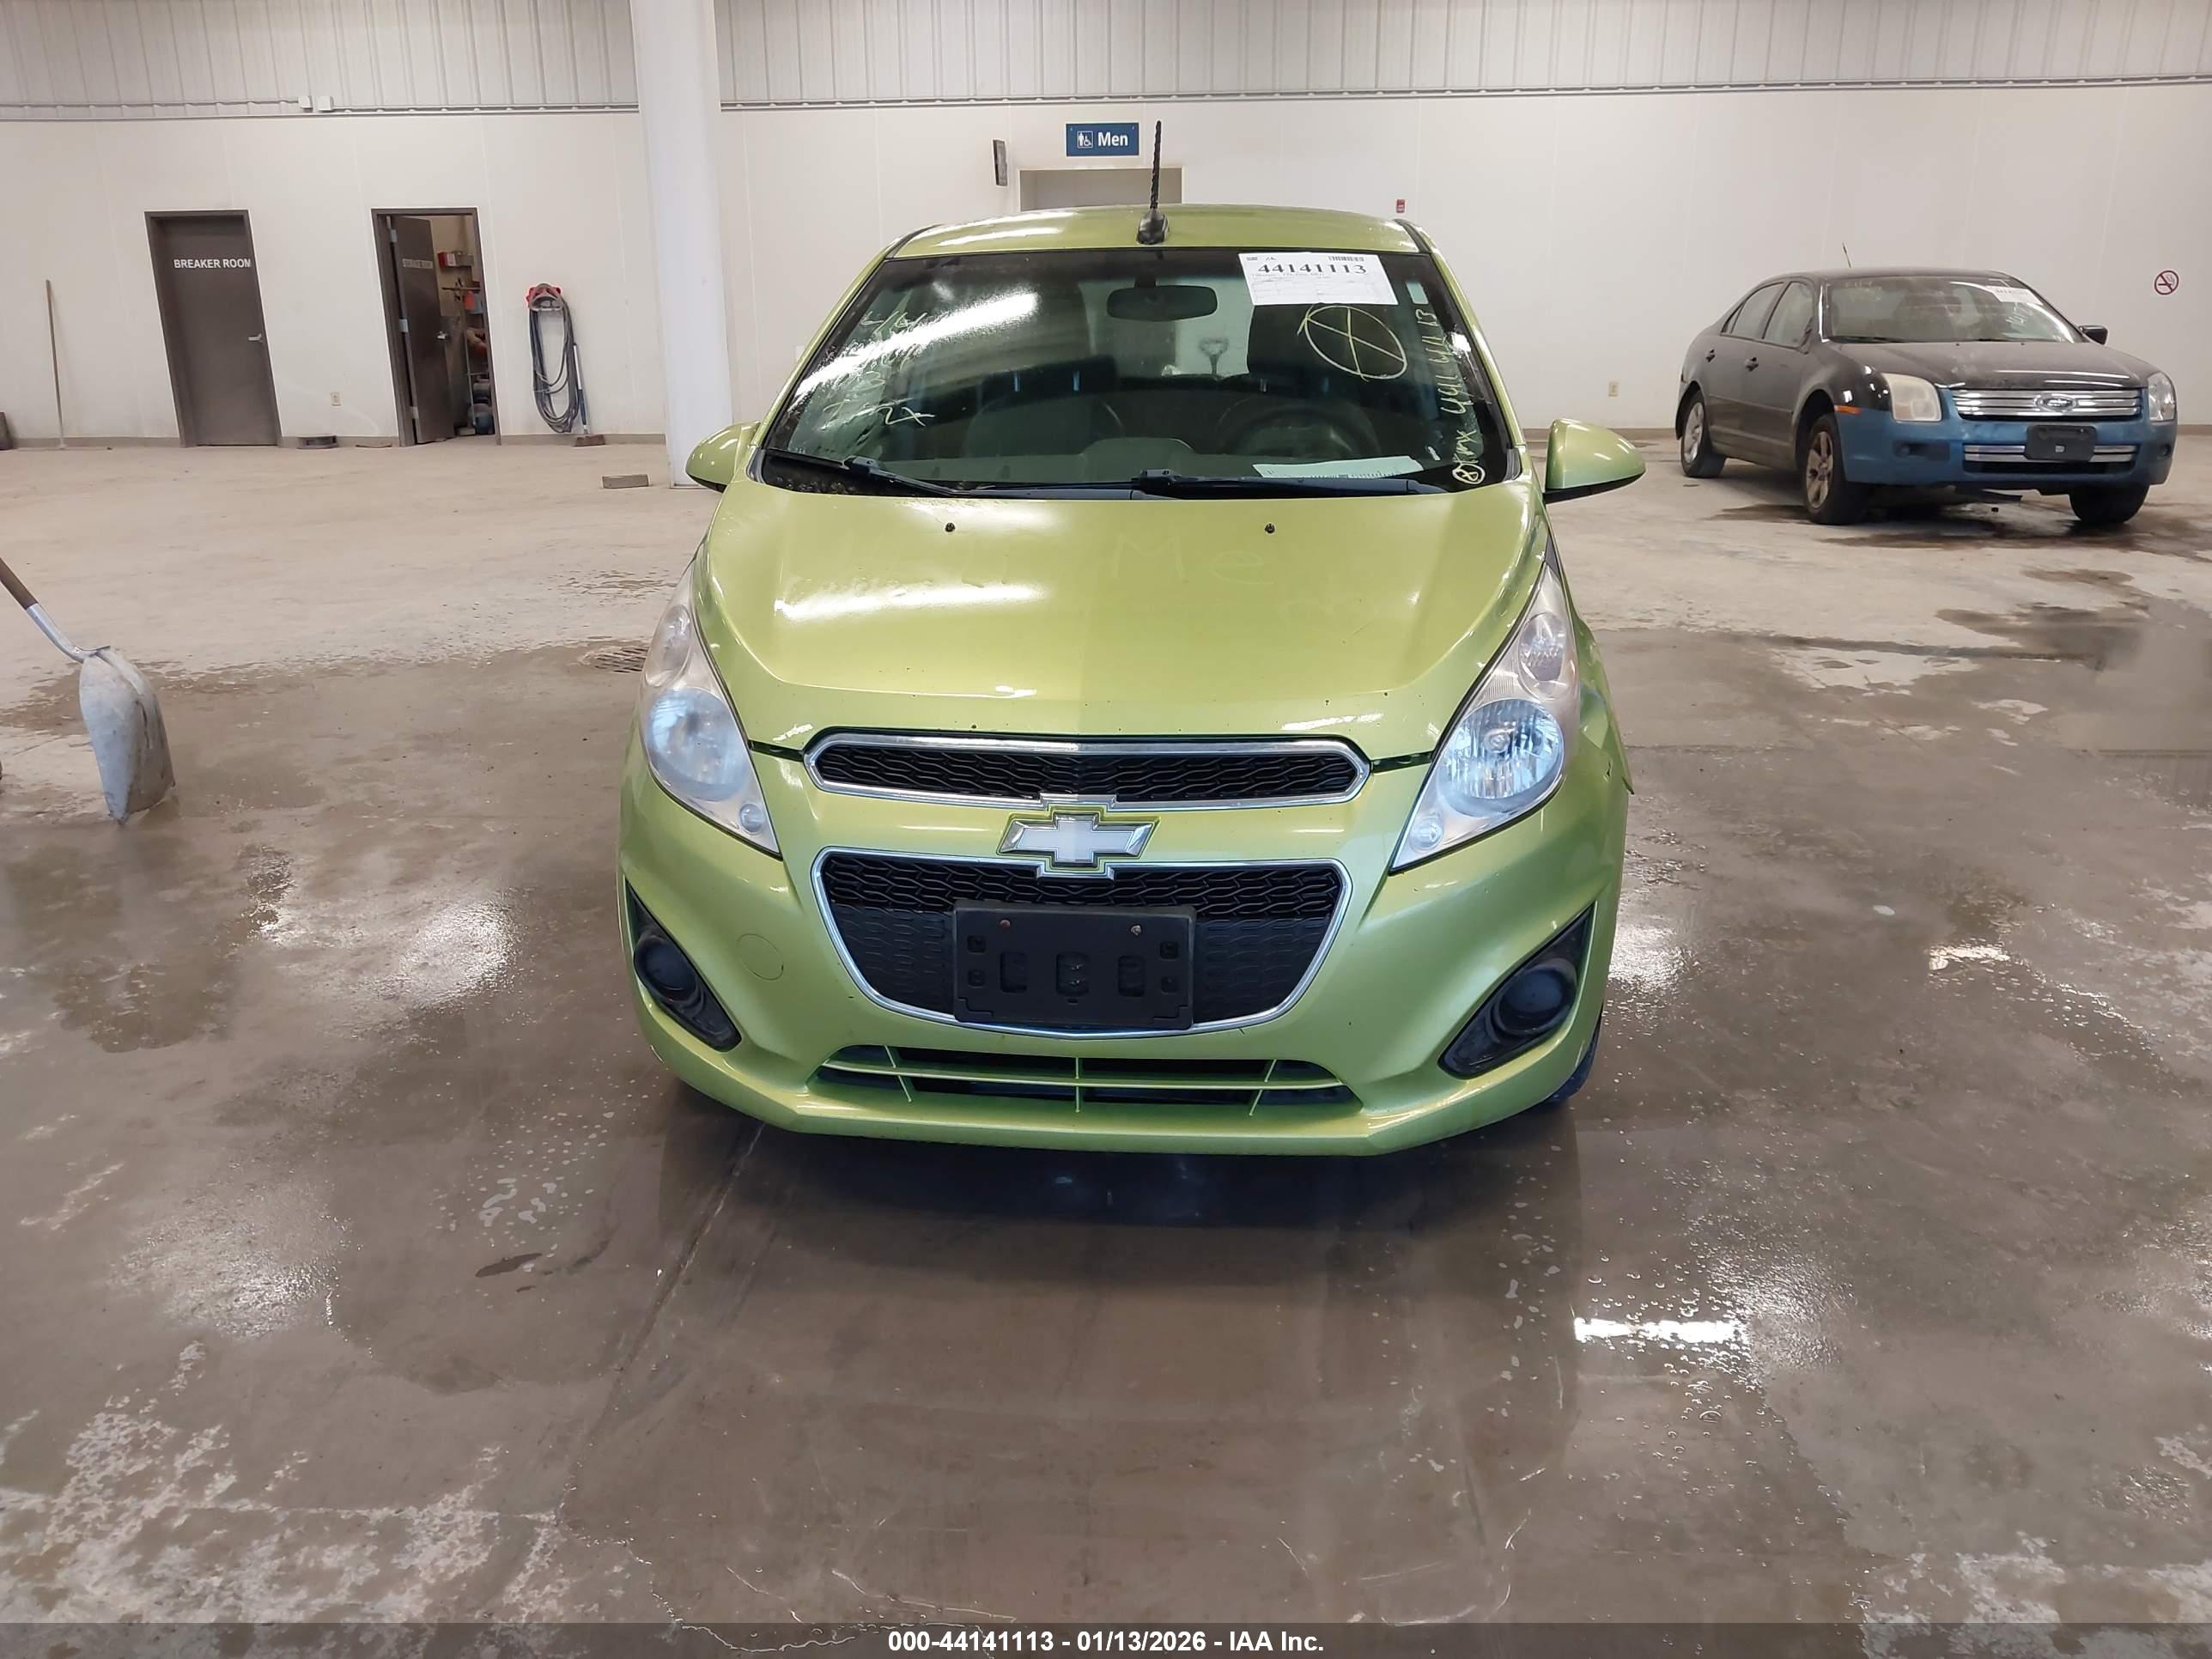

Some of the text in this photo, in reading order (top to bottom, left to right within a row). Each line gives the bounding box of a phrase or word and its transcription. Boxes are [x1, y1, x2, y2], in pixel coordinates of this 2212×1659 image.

[1097, 131, 1128, 147] Men
[173, 258, 252, 269] BREAKER ROOM
[1257, 263, 1367, 275] 44141113
